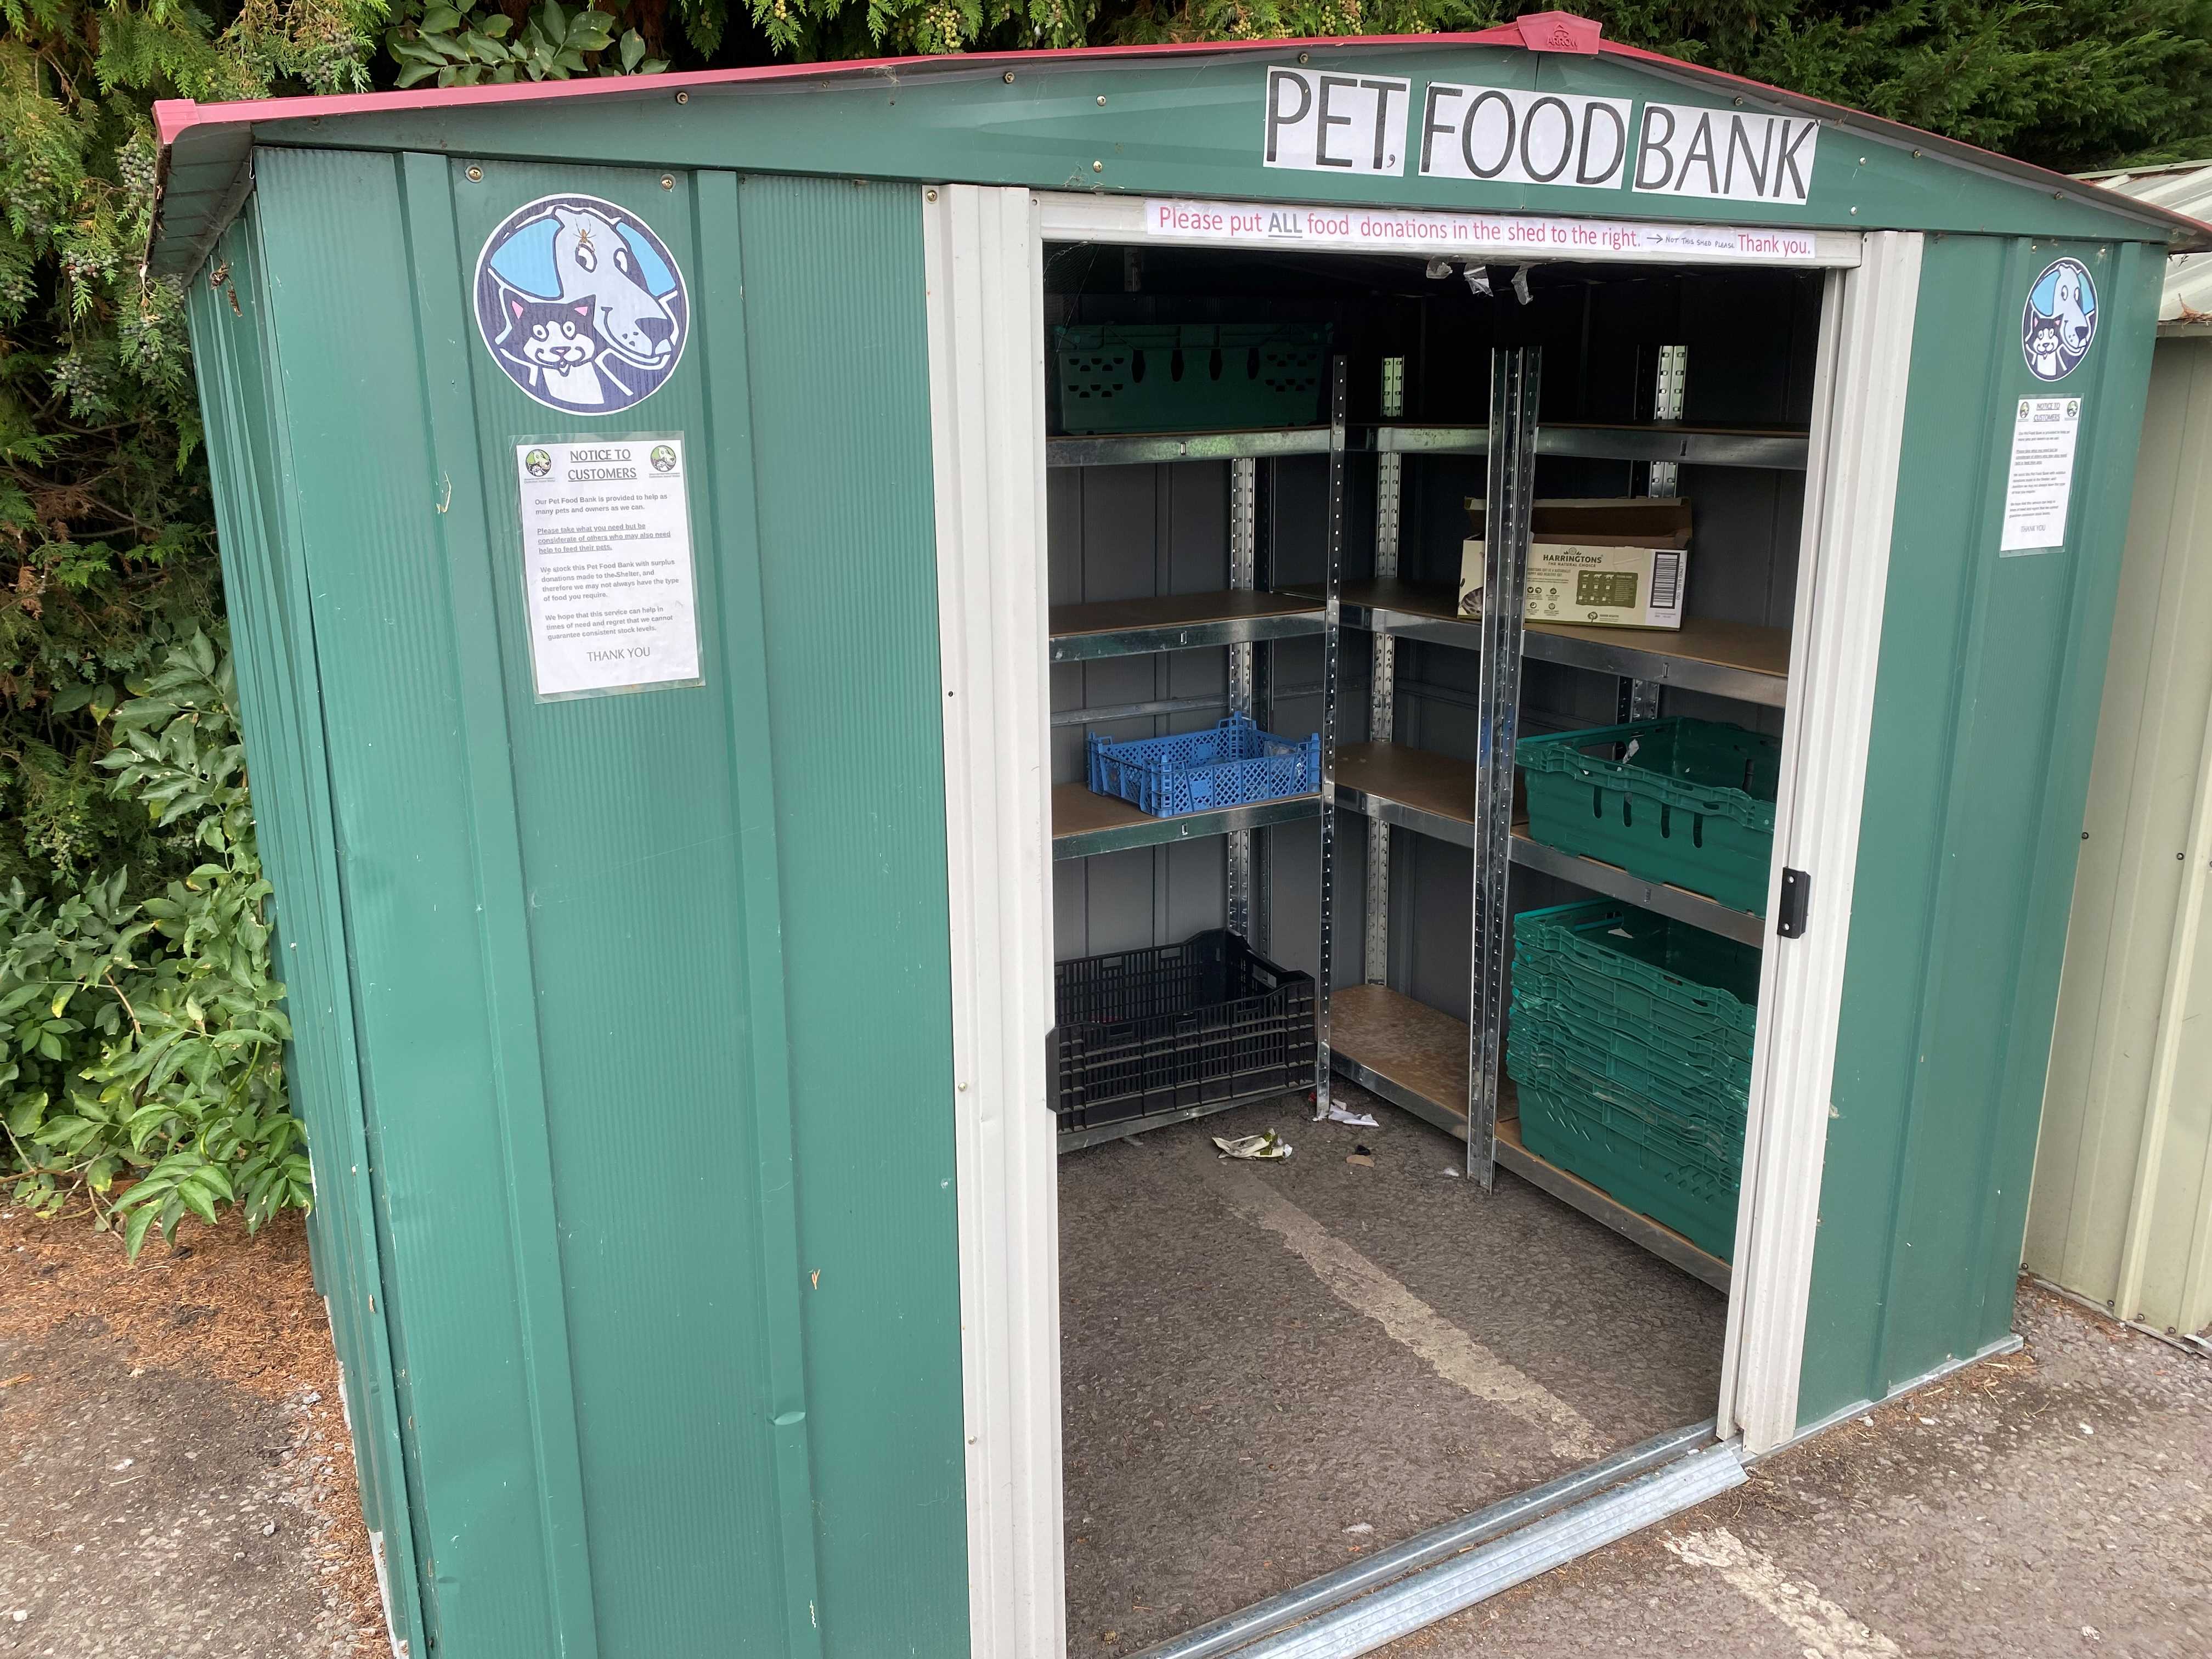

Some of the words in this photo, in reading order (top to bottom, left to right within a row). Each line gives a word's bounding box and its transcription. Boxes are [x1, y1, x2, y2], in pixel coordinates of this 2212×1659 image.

[1421, 87, 1624, 185] FOOD
[1635, 105, 1814, 199] BANK
[1160, 207, 1223, 230] Please
[1231, 213, 1262, 236] put
[1268, 212, 1302, 234] ALL
[1307, 212, 1349, 235] food
[1361, 216, 1447, 239] donations
[1453, 220, 1468, 239] in
[1473, 220, 1500, 241] the
[1508, 221, 1545, 242] shed
[1551, 225, 1567, 243] to
[1572, 225, 1596, 245] the
[1602, 227, 1640, 250] right.
[1738, 234, 1779, 253] Thank
[1782, 240, 1810, 257] you.
[570, 450, 612, 461] NOTICE
[614, 449, 631, 460] TO
[568, 467, 637, 480] CUSTOMERS
[1543, 554, 1602, 563] HARRINGTONS
[606, 618, 625, 627] regret
[548, 631, 580, 640] guarantee
[582, 628, 616, 636] consistent
[587, 648, 624, 662] THANK
[627, 647, 651, 658] YOU
